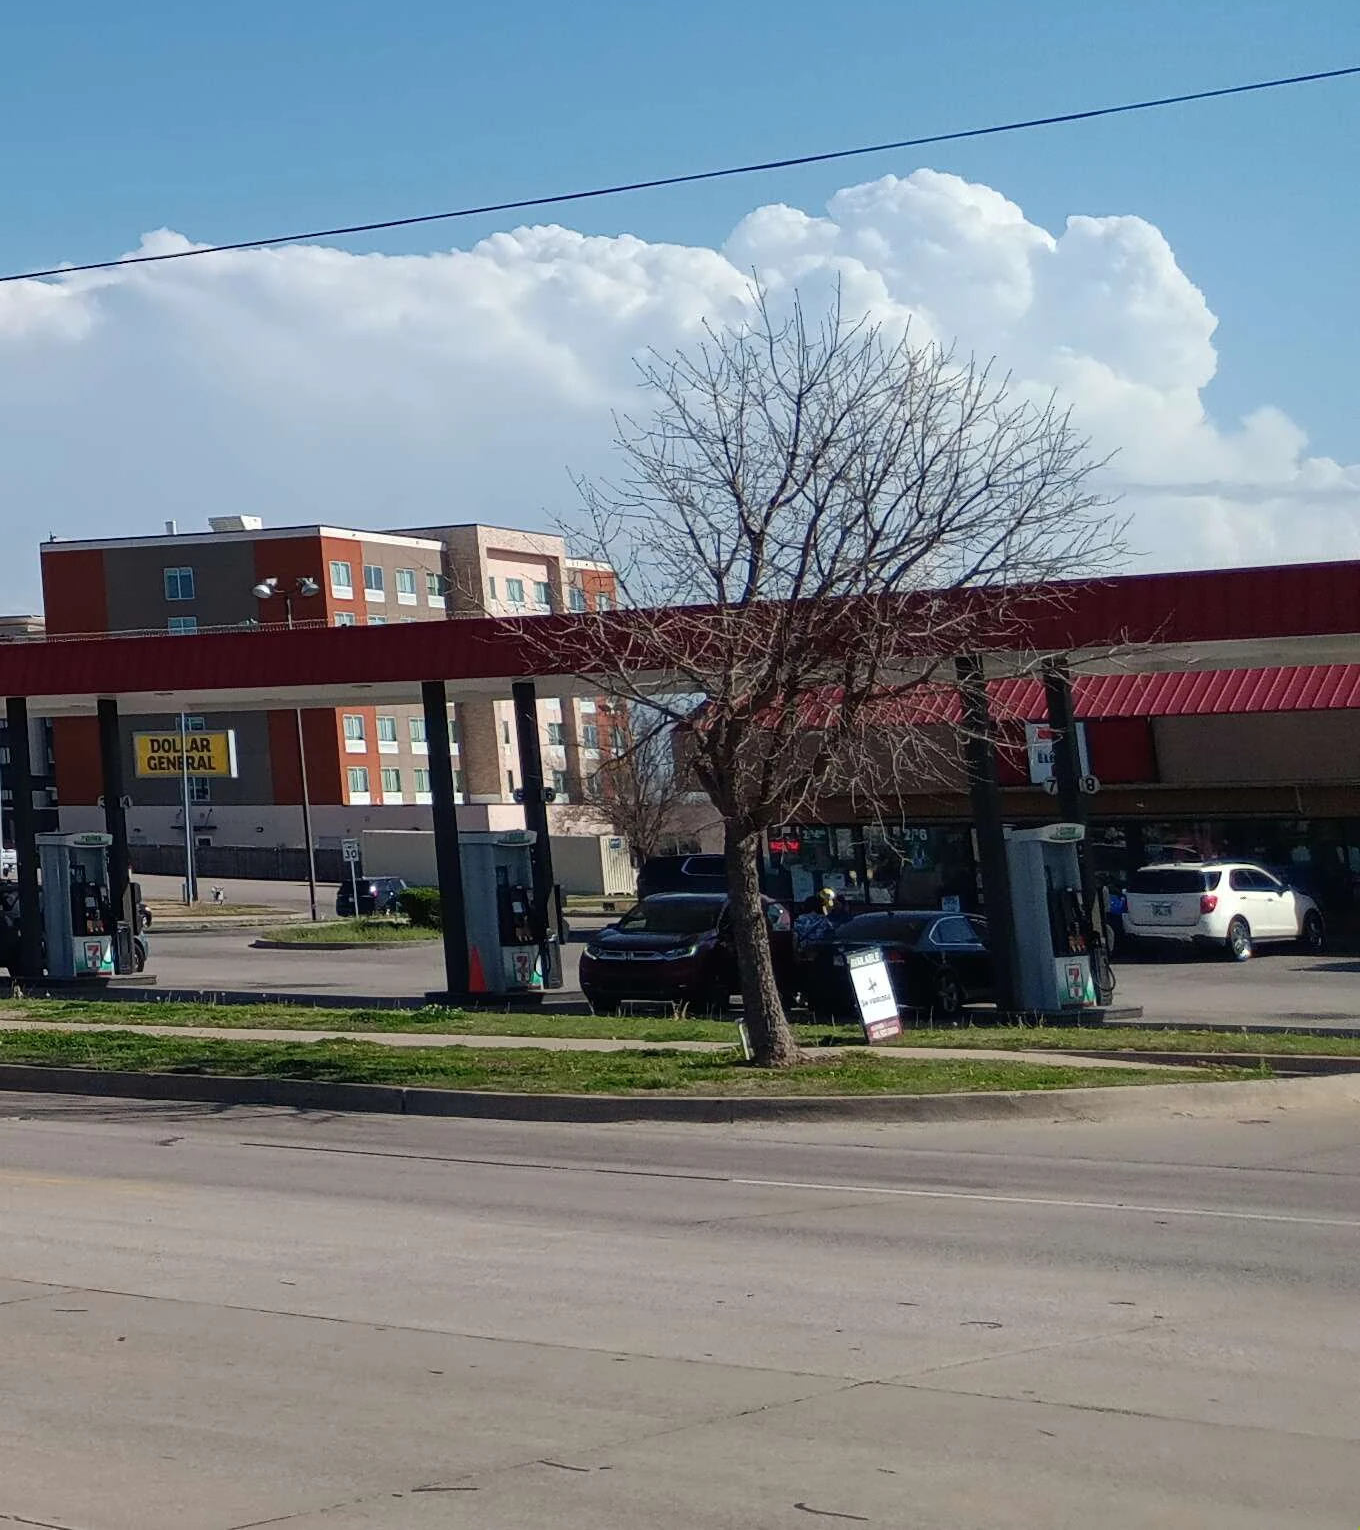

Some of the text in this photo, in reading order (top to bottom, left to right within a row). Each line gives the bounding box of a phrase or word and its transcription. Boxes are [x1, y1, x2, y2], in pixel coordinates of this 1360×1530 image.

[150, 738, 211, 753] DOLLAR
[147, 755, 216, 771] GENERAL
[1085, 778, 1095, 791] 8
